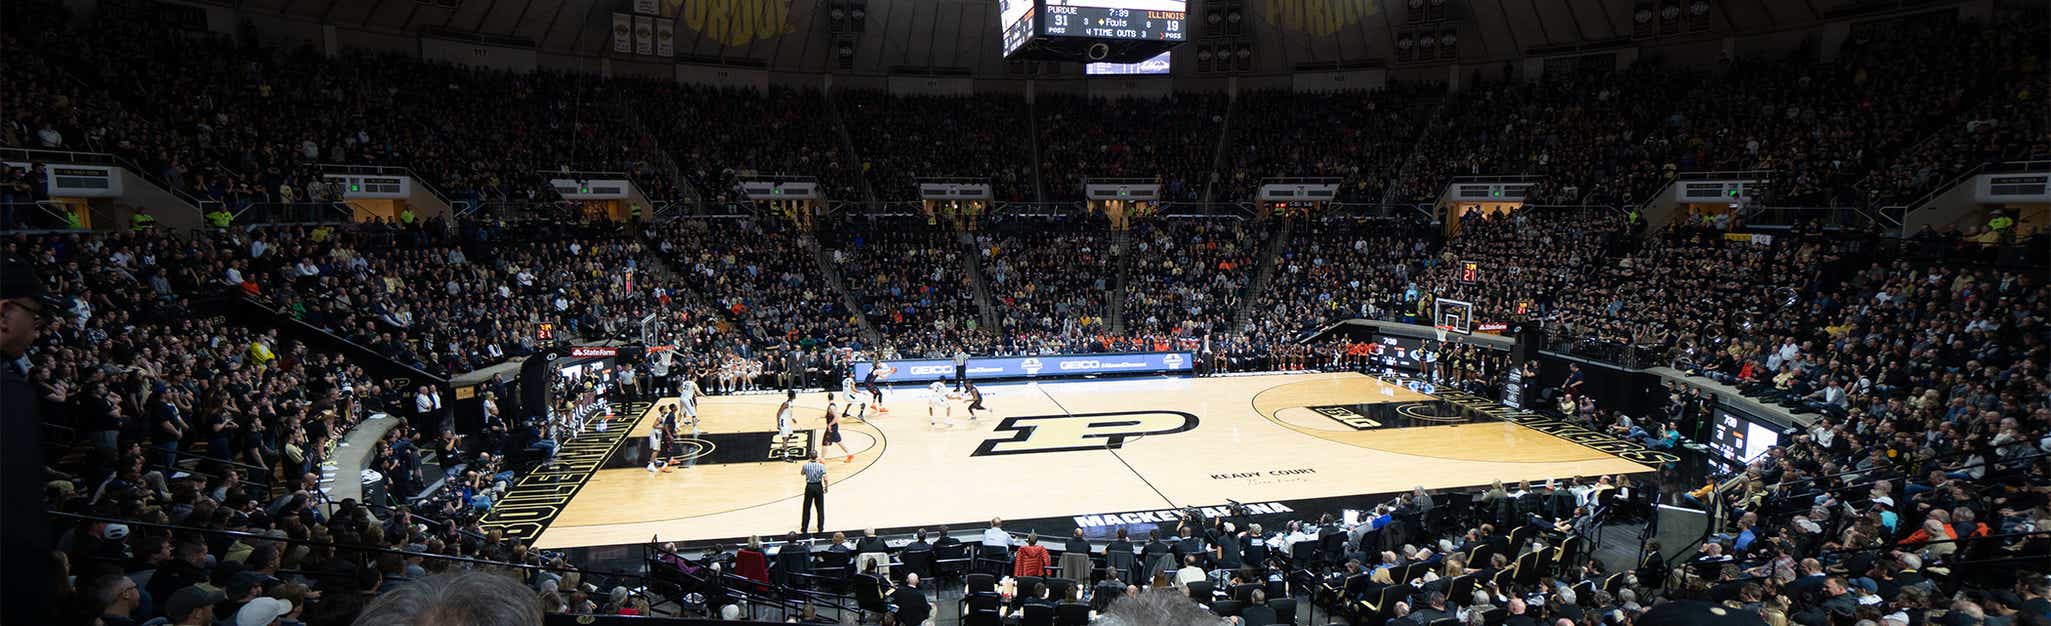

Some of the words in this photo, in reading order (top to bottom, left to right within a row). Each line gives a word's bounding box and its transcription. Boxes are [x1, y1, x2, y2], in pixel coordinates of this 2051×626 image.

[1047, 6, 1078, 15] PURDUE
[1147, 11, 1185, 20] ILLINOIS
[1105, 17, 1127, 27] Fouls
[1094, 28, 1113, 37] TIME
[1116, 29, 1137, 38] OUTS
[1463, 269, 1475, 281] 21
[911, 365, 953, 375] GEICO
[1060, 360, 1100, 370] GEICO
[970, 410, 1199, 457] P
[1210, 471, 1261, 480] KEADY
[1269, 468, 1317, 477] COURT
[1202, 502, 1295, 519] ARNA
